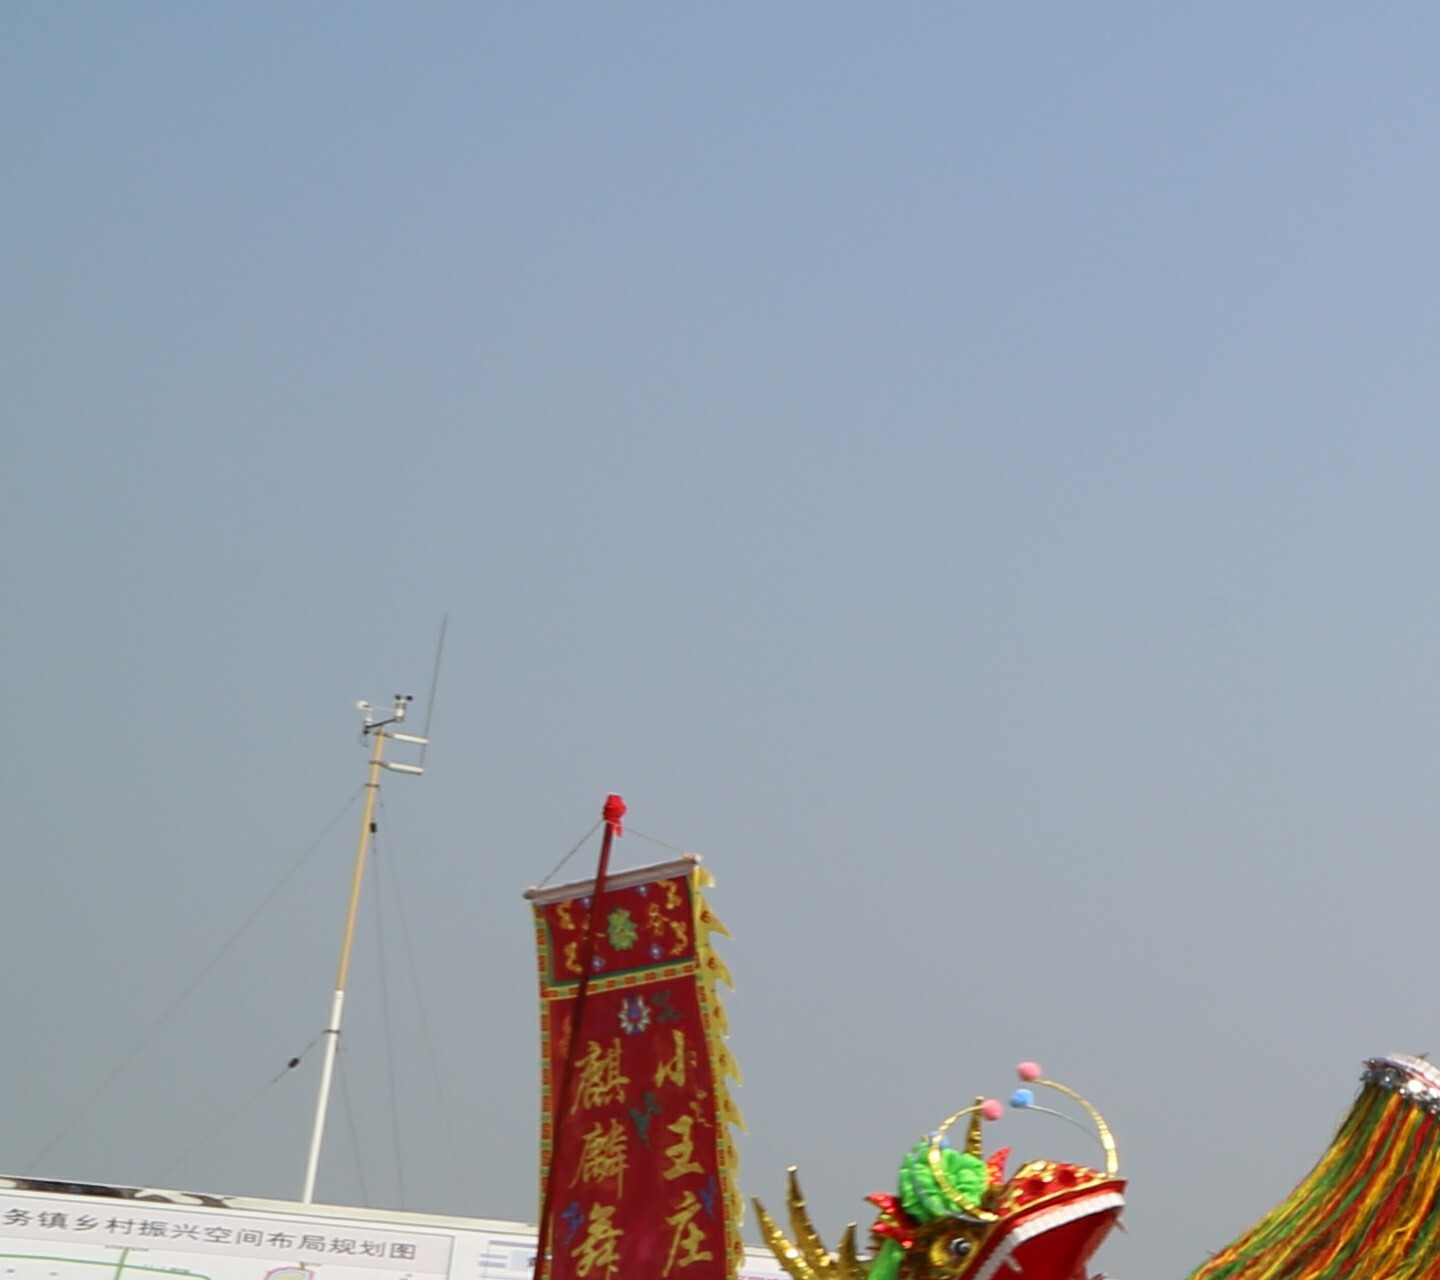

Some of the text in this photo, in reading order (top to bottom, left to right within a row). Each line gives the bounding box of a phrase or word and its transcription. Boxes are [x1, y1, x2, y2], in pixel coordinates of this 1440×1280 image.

[653, 1029, 714, 1279] 小王庄
[3, 1207, 417, 1261] 务镇乡村振兴空间布局规划图
